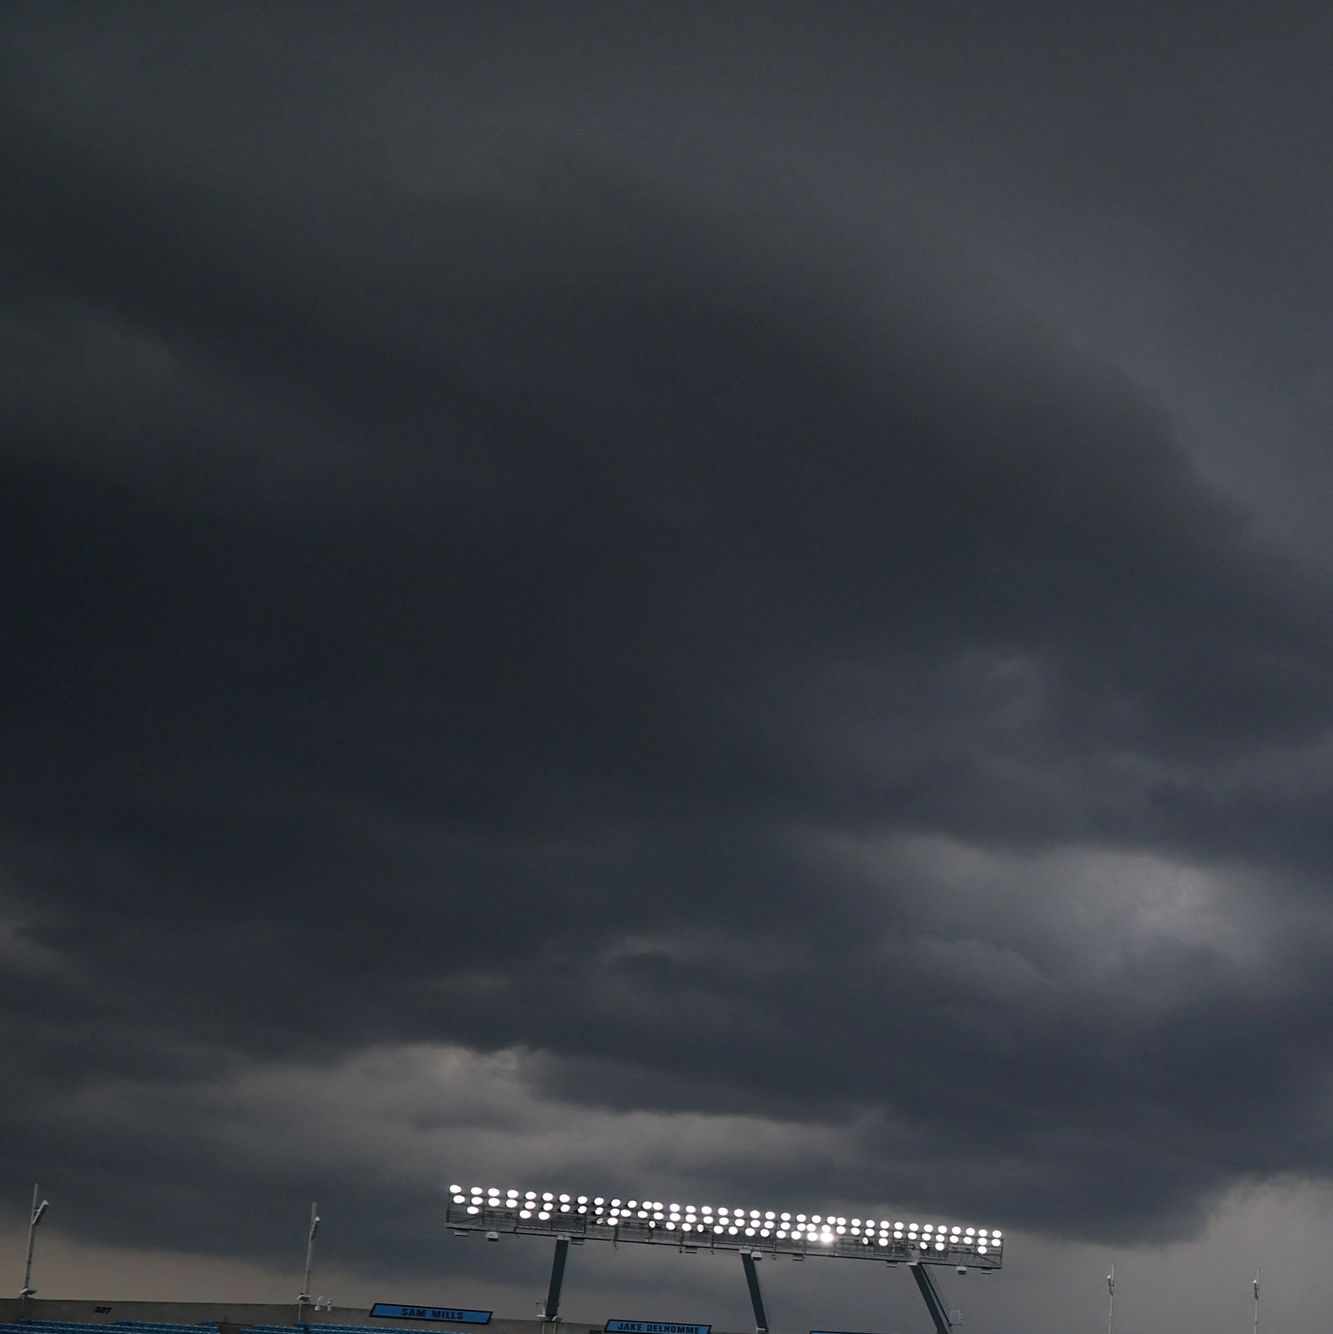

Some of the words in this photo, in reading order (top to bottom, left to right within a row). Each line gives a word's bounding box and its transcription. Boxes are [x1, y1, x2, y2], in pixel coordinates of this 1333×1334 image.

[401, 1307, 427, 1319] SAM
[431, 1309, 464, 1321] MILLS
[617, 1322, 643, 1332] JAKE
[647, 1323, 700, 1334] DELHOMME
